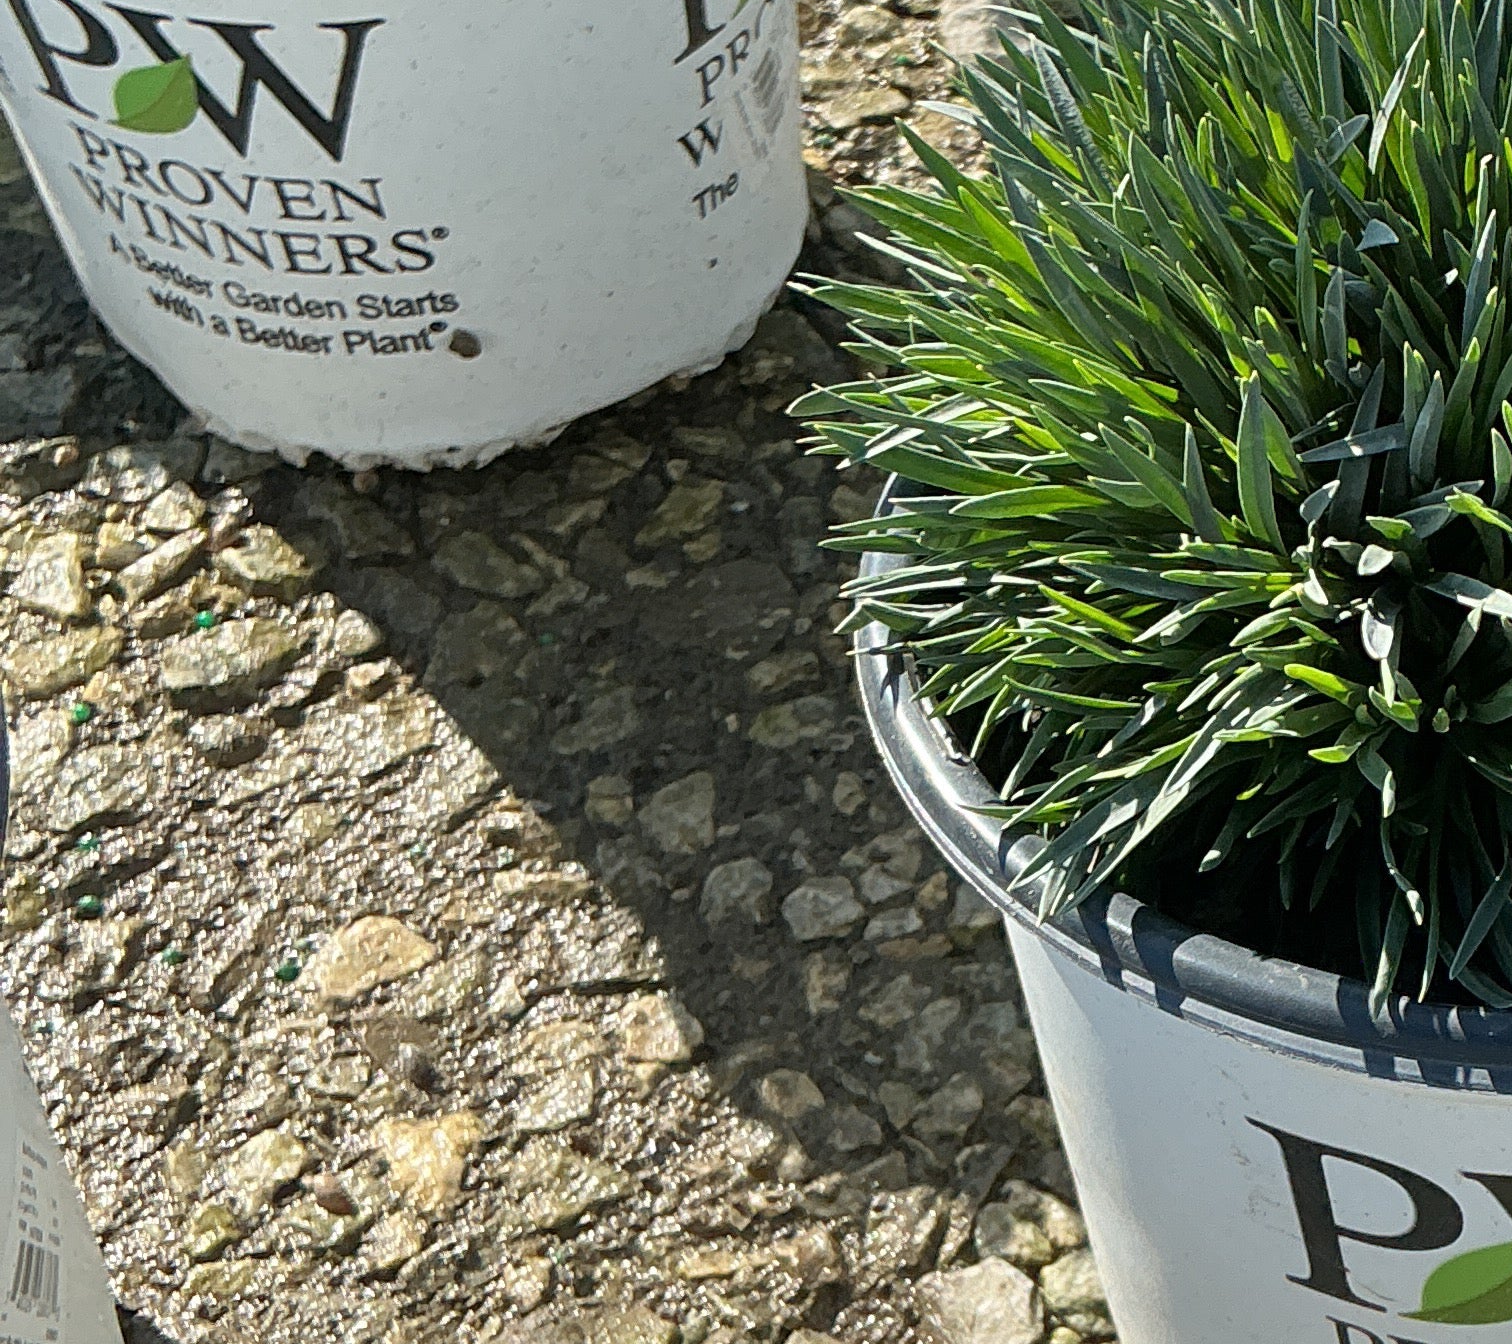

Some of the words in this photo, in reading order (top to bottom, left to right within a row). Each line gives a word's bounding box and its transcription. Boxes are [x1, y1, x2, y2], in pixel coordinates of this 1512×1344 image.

[69, 120, 387, 223] PROVEN
[692, 170, 740, 219] The
[109, 232, 131, 264] A
[128, 244, 214, 298] Better
[223, 279, 347, 320] Garden
[357, 289, 459, 321] Starts
[147, 284, 204, 328] with
[211, 314, 229, 337] a
[235, 316, 334, 355] Better
